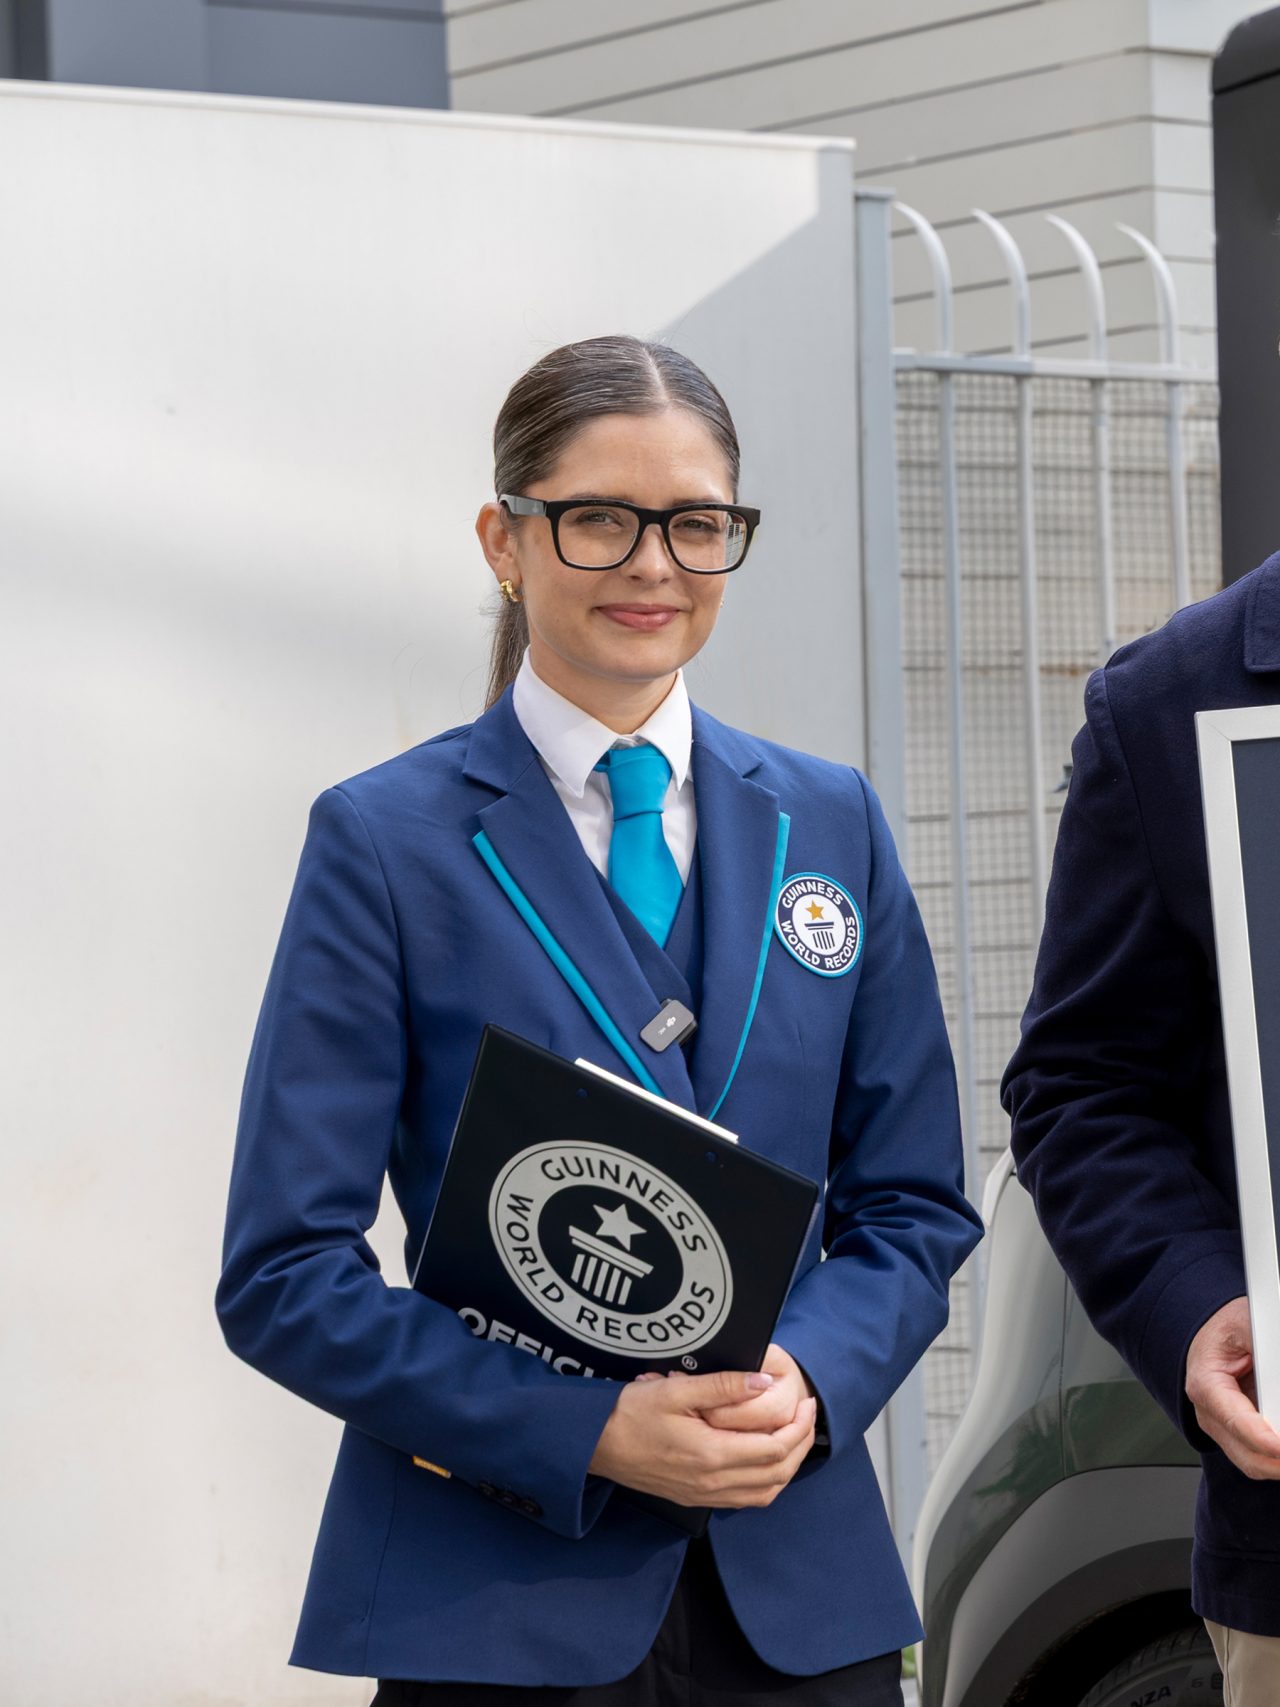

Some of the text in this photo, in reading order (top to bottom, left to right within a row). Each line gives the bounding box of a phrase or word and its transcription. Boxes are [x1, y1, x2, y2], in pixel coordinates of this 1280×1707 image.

[781, 881, 844, 909] GUINNESS
[781, 916, 856, 969] WORLD RECORDS
[540, 1156, 708, 1253] GUINNESS
[505, 1193, 715, 1344] WORLD RECORDS
